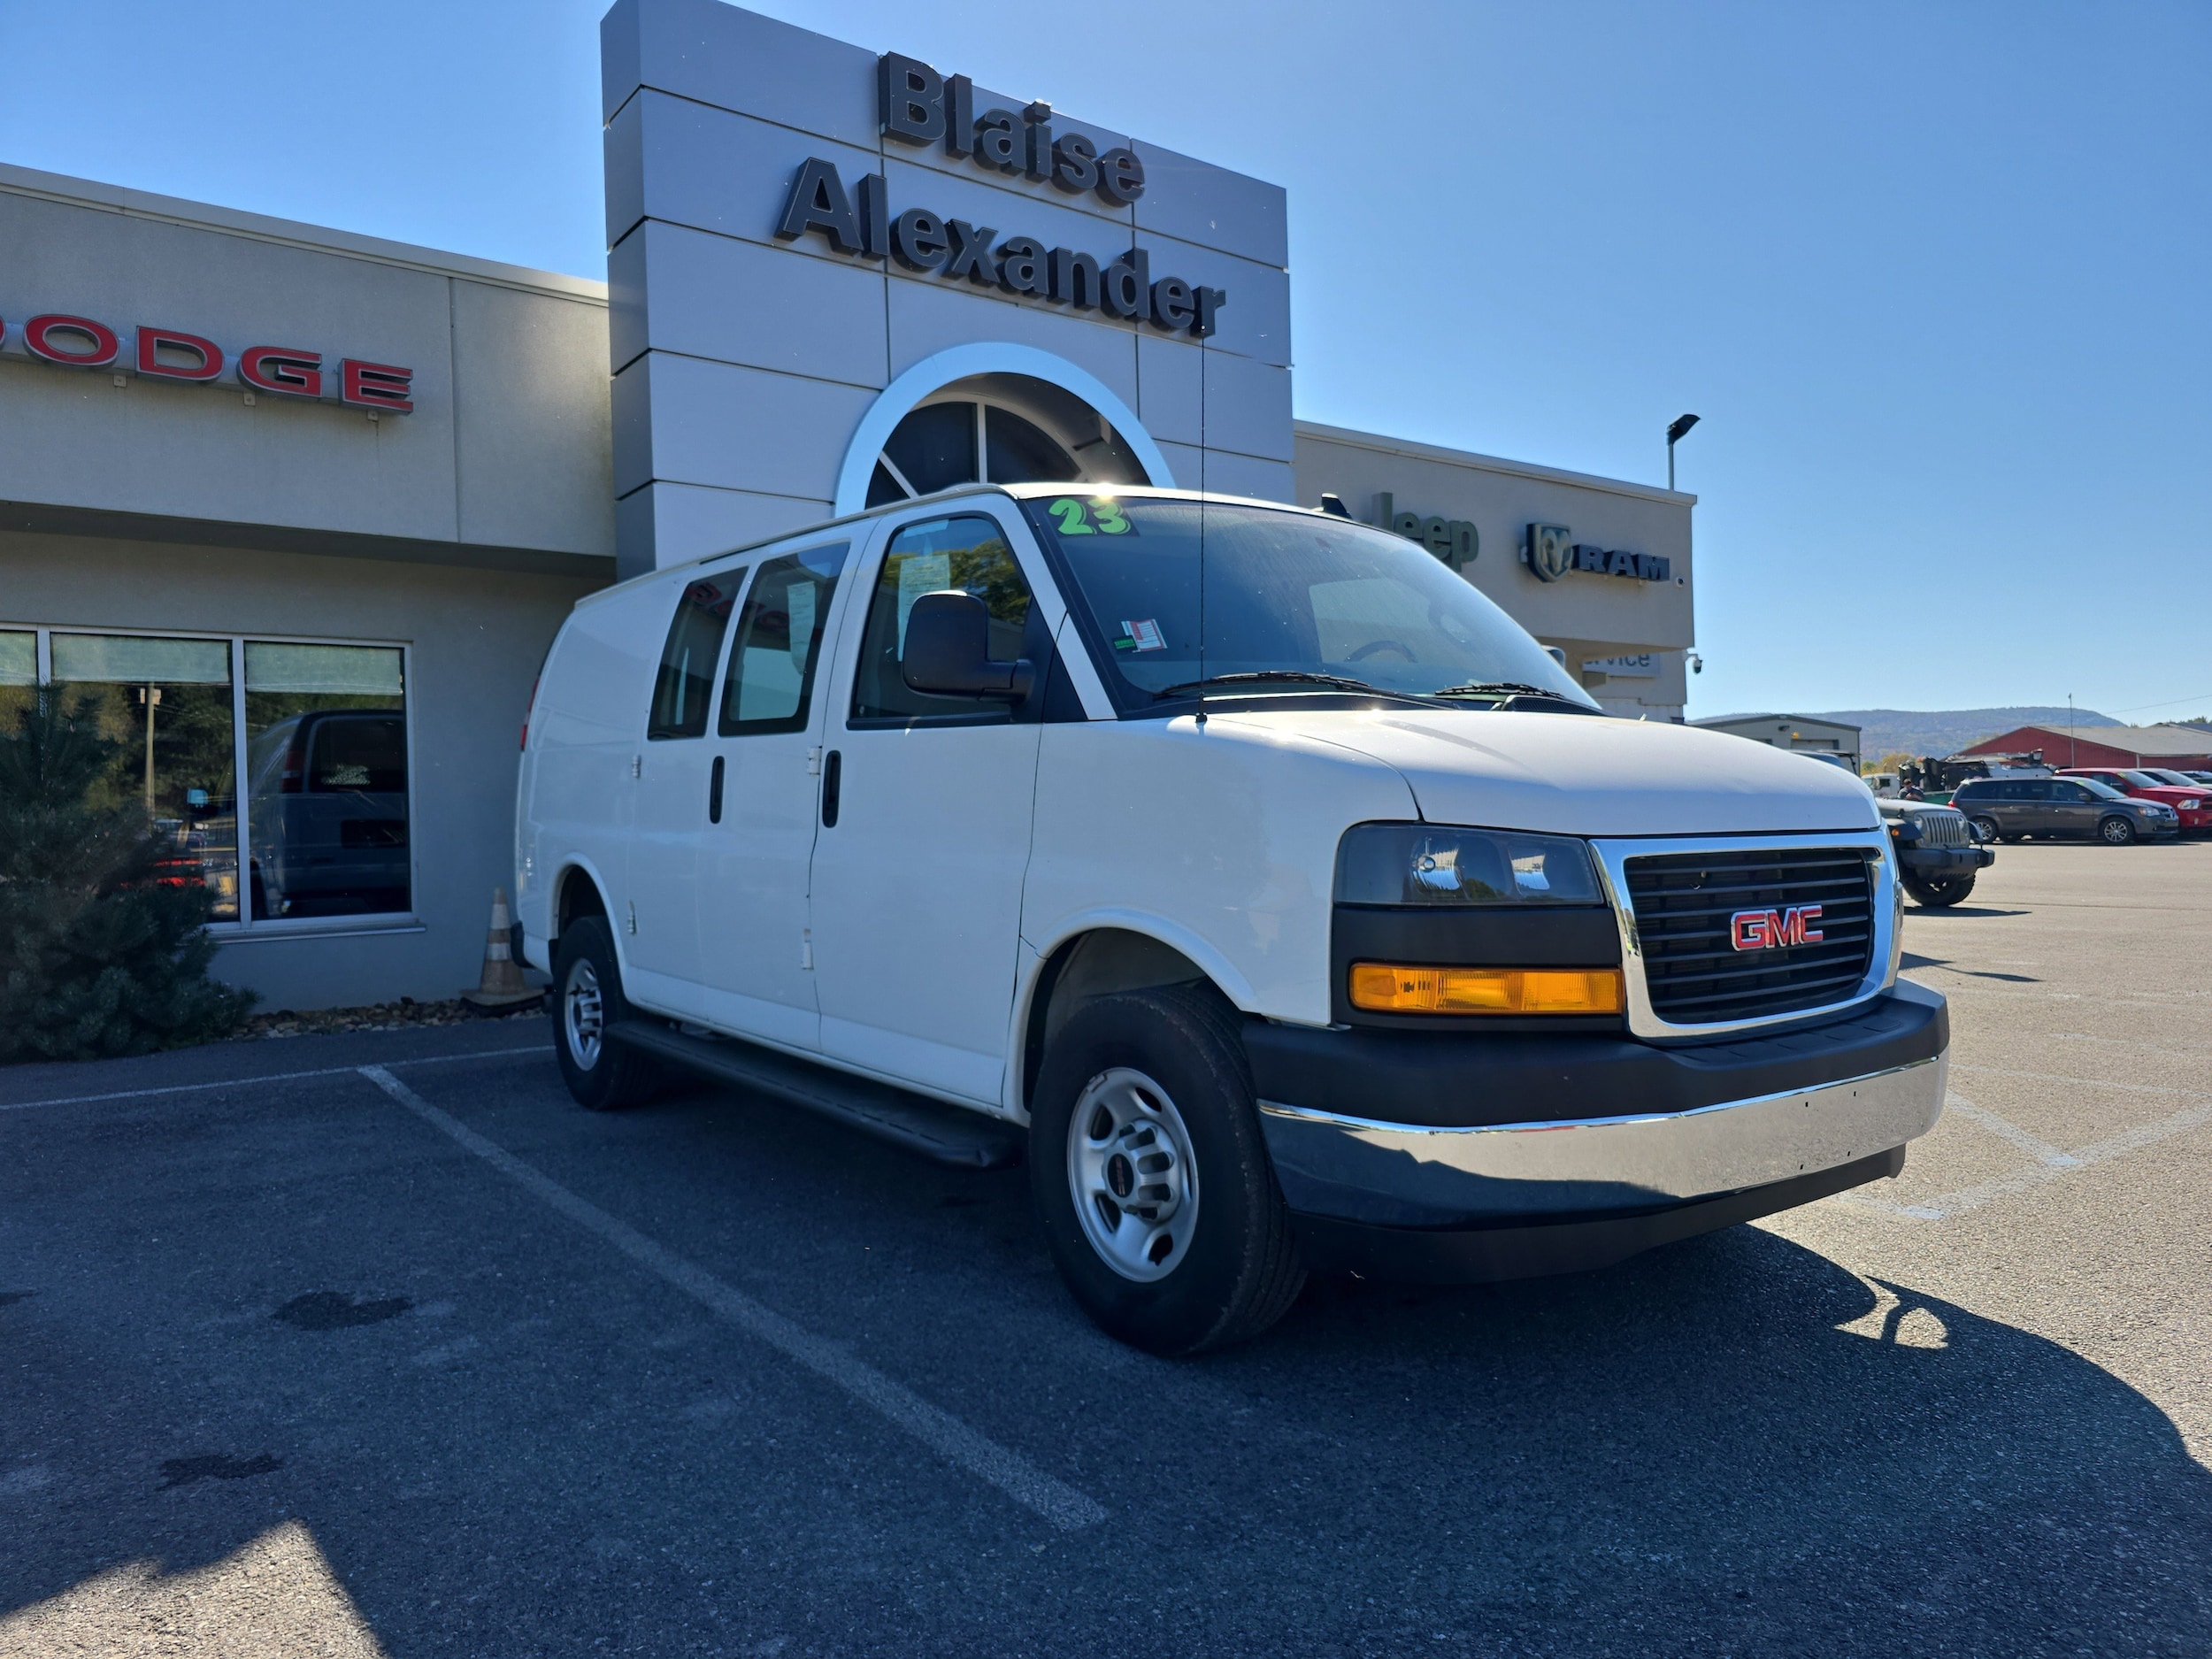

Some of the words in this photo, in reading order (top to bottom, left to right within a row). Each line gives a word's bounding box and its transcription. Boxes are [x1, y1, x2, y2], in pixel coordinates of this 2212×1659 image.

[879, 51, 1145, 207] Blaise
[774, 157, 1226, 338] Alexander
[0, 313, 414, 415] ODGE
[1048, 497, 1131, 535] 23
[1572, 544, 1671, 582] RAM
[1730, 904, 1824, 952] GMC
